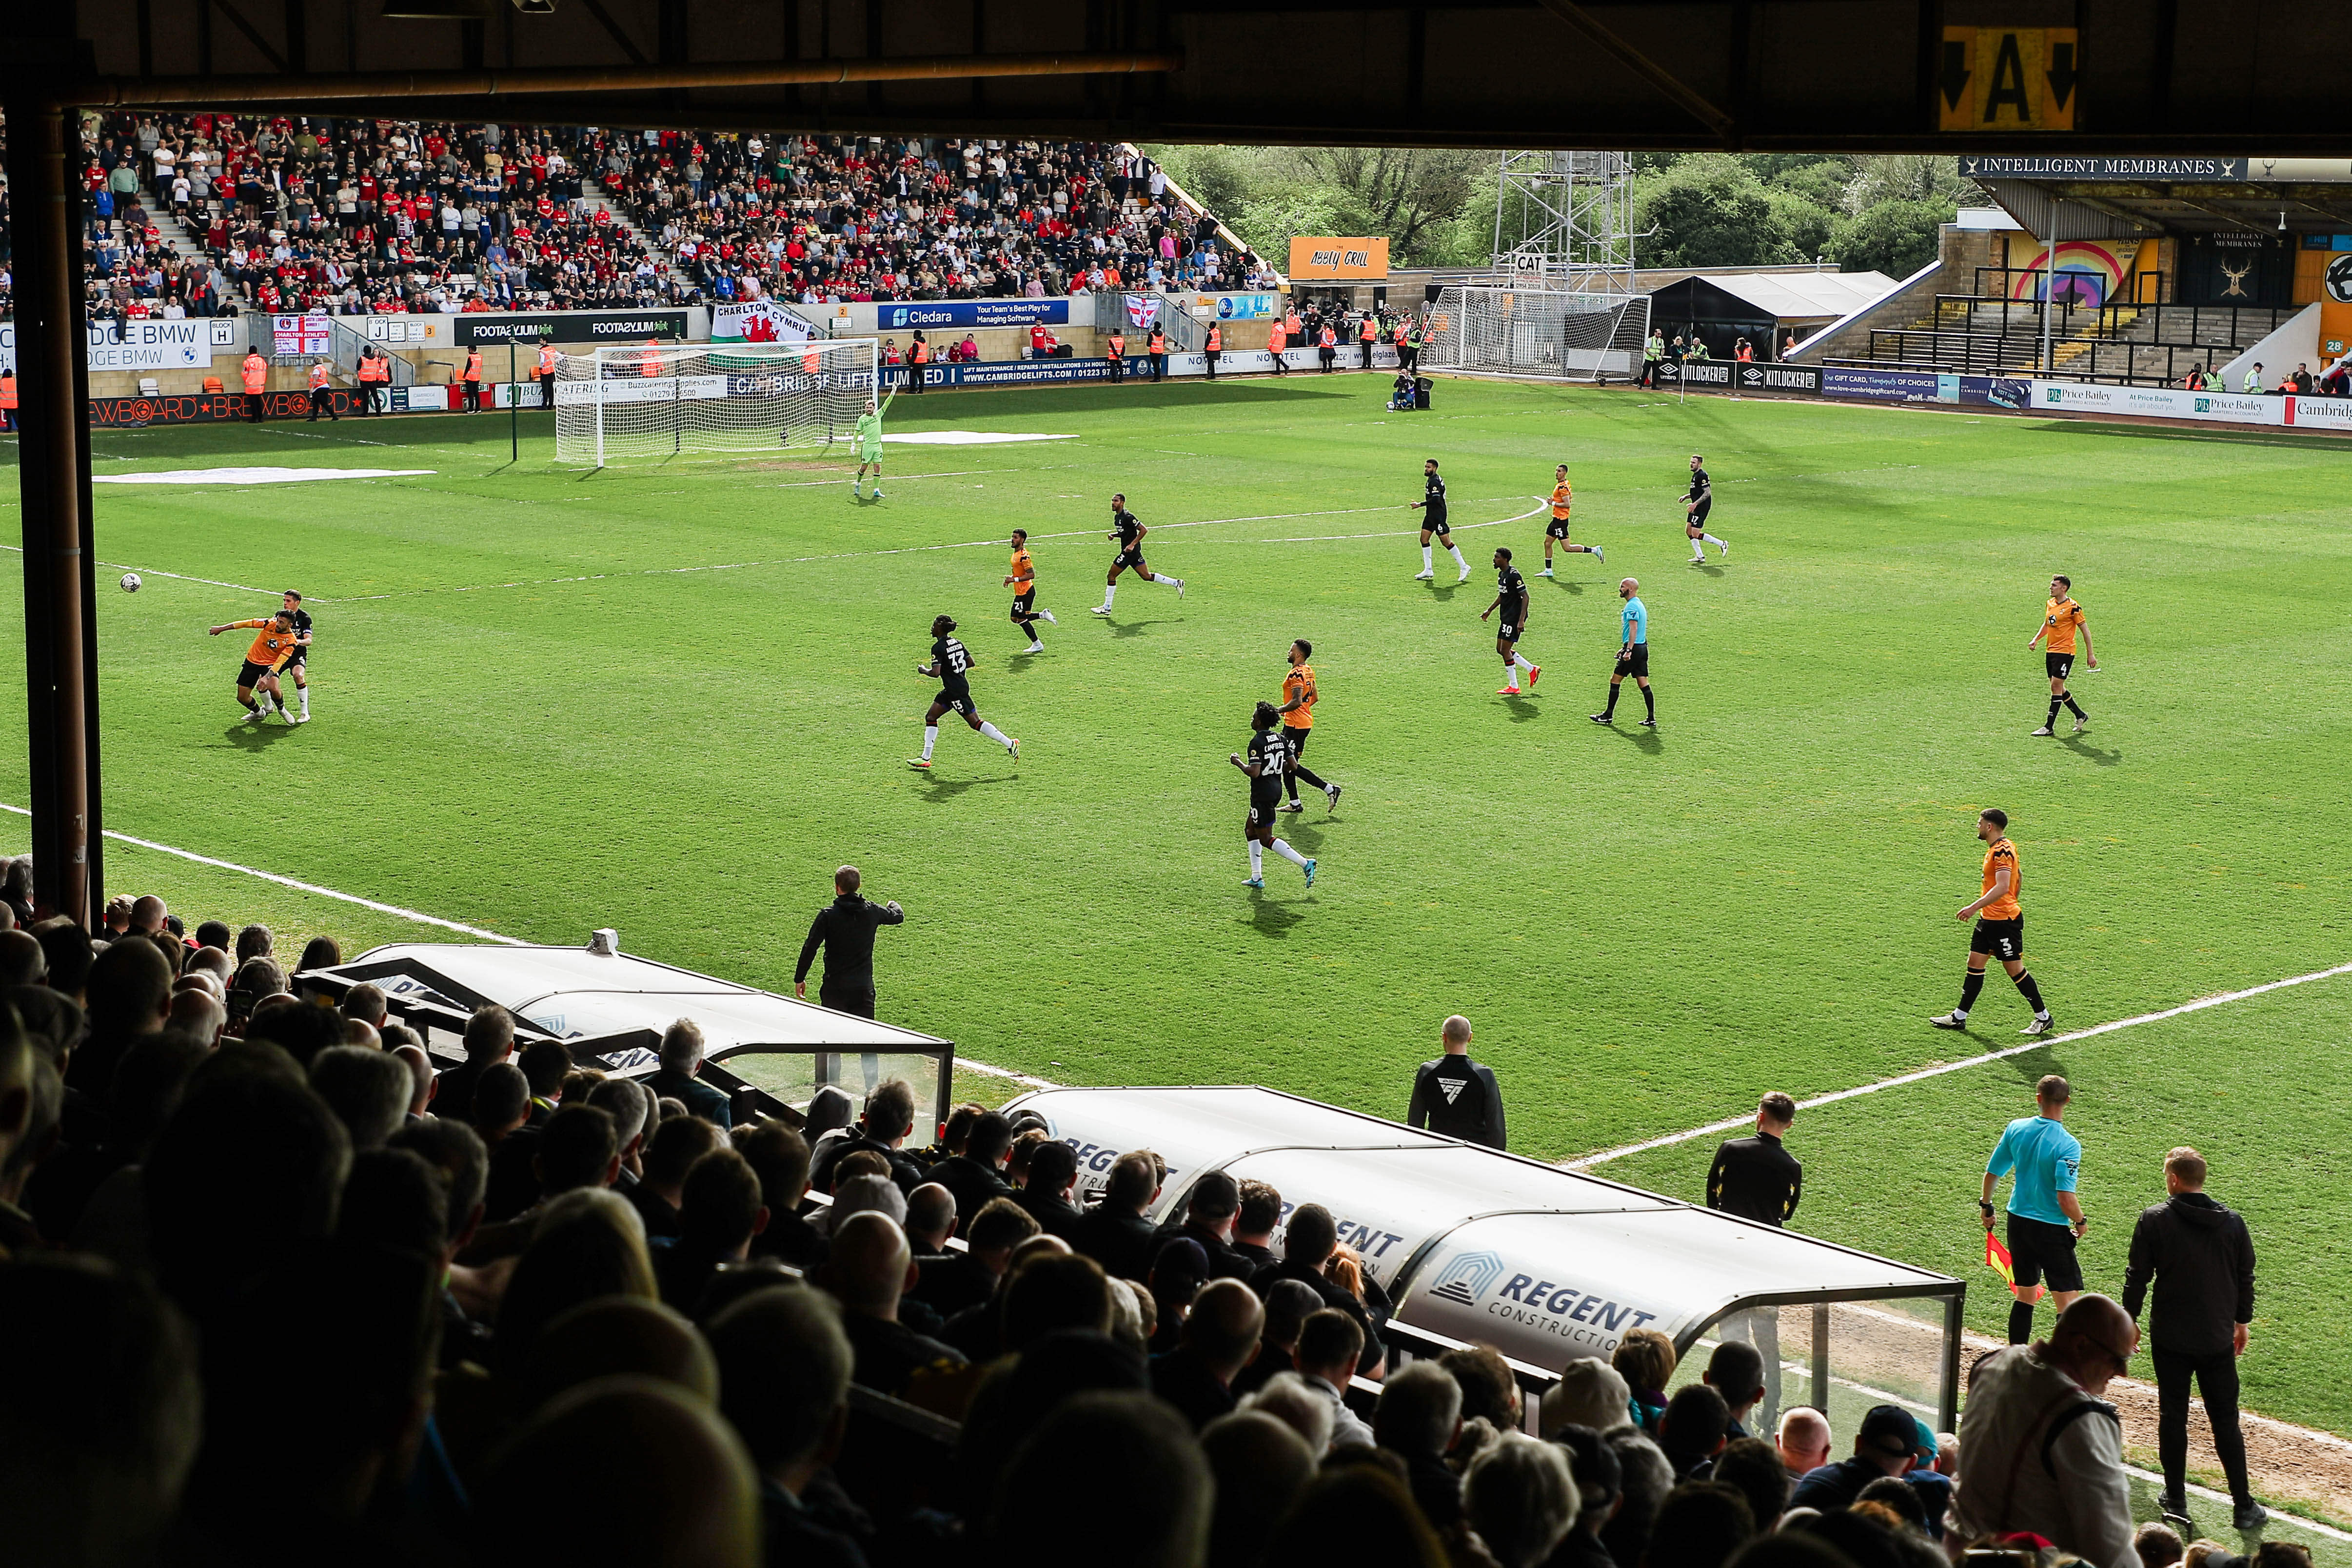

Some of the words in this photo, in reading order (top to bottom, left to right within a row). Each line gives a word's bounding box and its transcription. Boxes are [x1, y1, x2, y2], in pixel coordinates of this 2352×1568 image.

[1983, 34, 2031, 122] A
[1983, 158, 2098, 173] INTELLIGENT
[2105, 159, 2215, 174] MEMBRANES
[1344, 251, 1367, 266] GRILL
[1518, 257, 1542, 270] CAT
[1028, 304, 1041, 313] Play
[718, 303, 768, 316] CHARLTON
[772, 312, 805, 332] CYMRU
[909, 310, 952, 323] Cledara
[977, 316, 1007, 324] Managing
[143, 324, 196, 343] BMW
[375, 327, 381, 337] J
[593, 321, 653, 334] FOOTASYLUM
[218, 331, 226, 341] H
[2328, 341, 2341, 351] 28
[122, 349, 162, 364] BMW
[1188, 356, 1233, 365] NOVTEL
[885, 368, 944, 386] LIMED
[963, 370, 1071, 382] WWW.CAMBRIDGELIFTS.COM
[1681, 364, 1718, 382] KITLOCKER
[1766, 370, 1805, 388] KITLOCKER
[1825, 385, 1907, 396] www.love-cambridgegiftcard.com
[2062, 389, 2083, 398] Price
[2086, 390, 2112, 403] Bailey
[214, 392, 350, 418] BREWBOD
[2211, 399, 2234, 409] Price
[2236, 400, 2264, 413] Bailey
[1014, 602, 1023, 610] 21
[1502, 624, 1513, 634] 30
[948, 650, 967, 674] 33
[2060, 663, 2067, 673] 4
[1262, 751, 1285, 776] 20
[2000, 938, 2012, 951] 3
[1499, 1273, 1656, 1332] REGENT
[1489, 1302, 1618, 1351] CONSTRUCTIO
